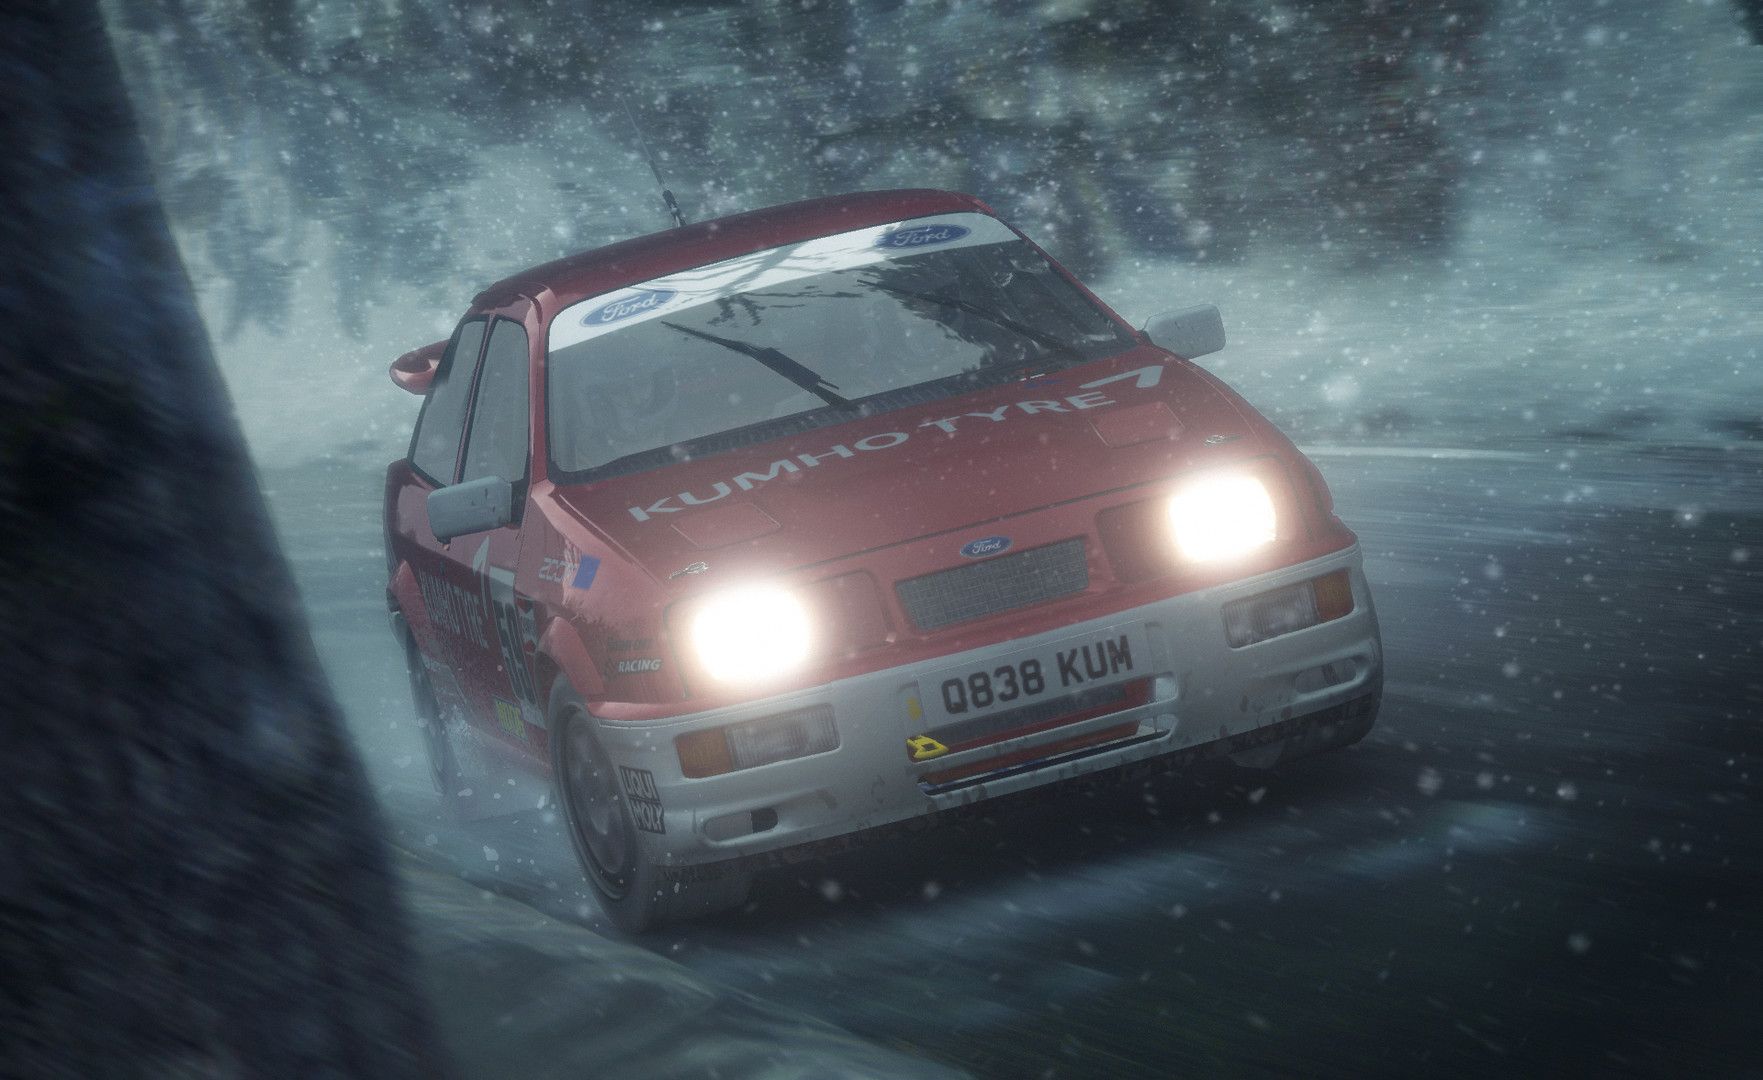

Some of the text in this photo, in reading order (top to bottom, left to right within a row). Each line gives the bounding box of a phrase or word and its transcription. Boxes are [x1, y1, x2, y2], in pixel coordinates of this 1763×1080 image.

[893, 226, 952, 247] Ford
[600, 292, 660, 322] Ford
[972, 539, 1002, 554] Ford
[617, 658, 662, 673] RACING
[940, 634, 1134, 715] Q838 KUM
